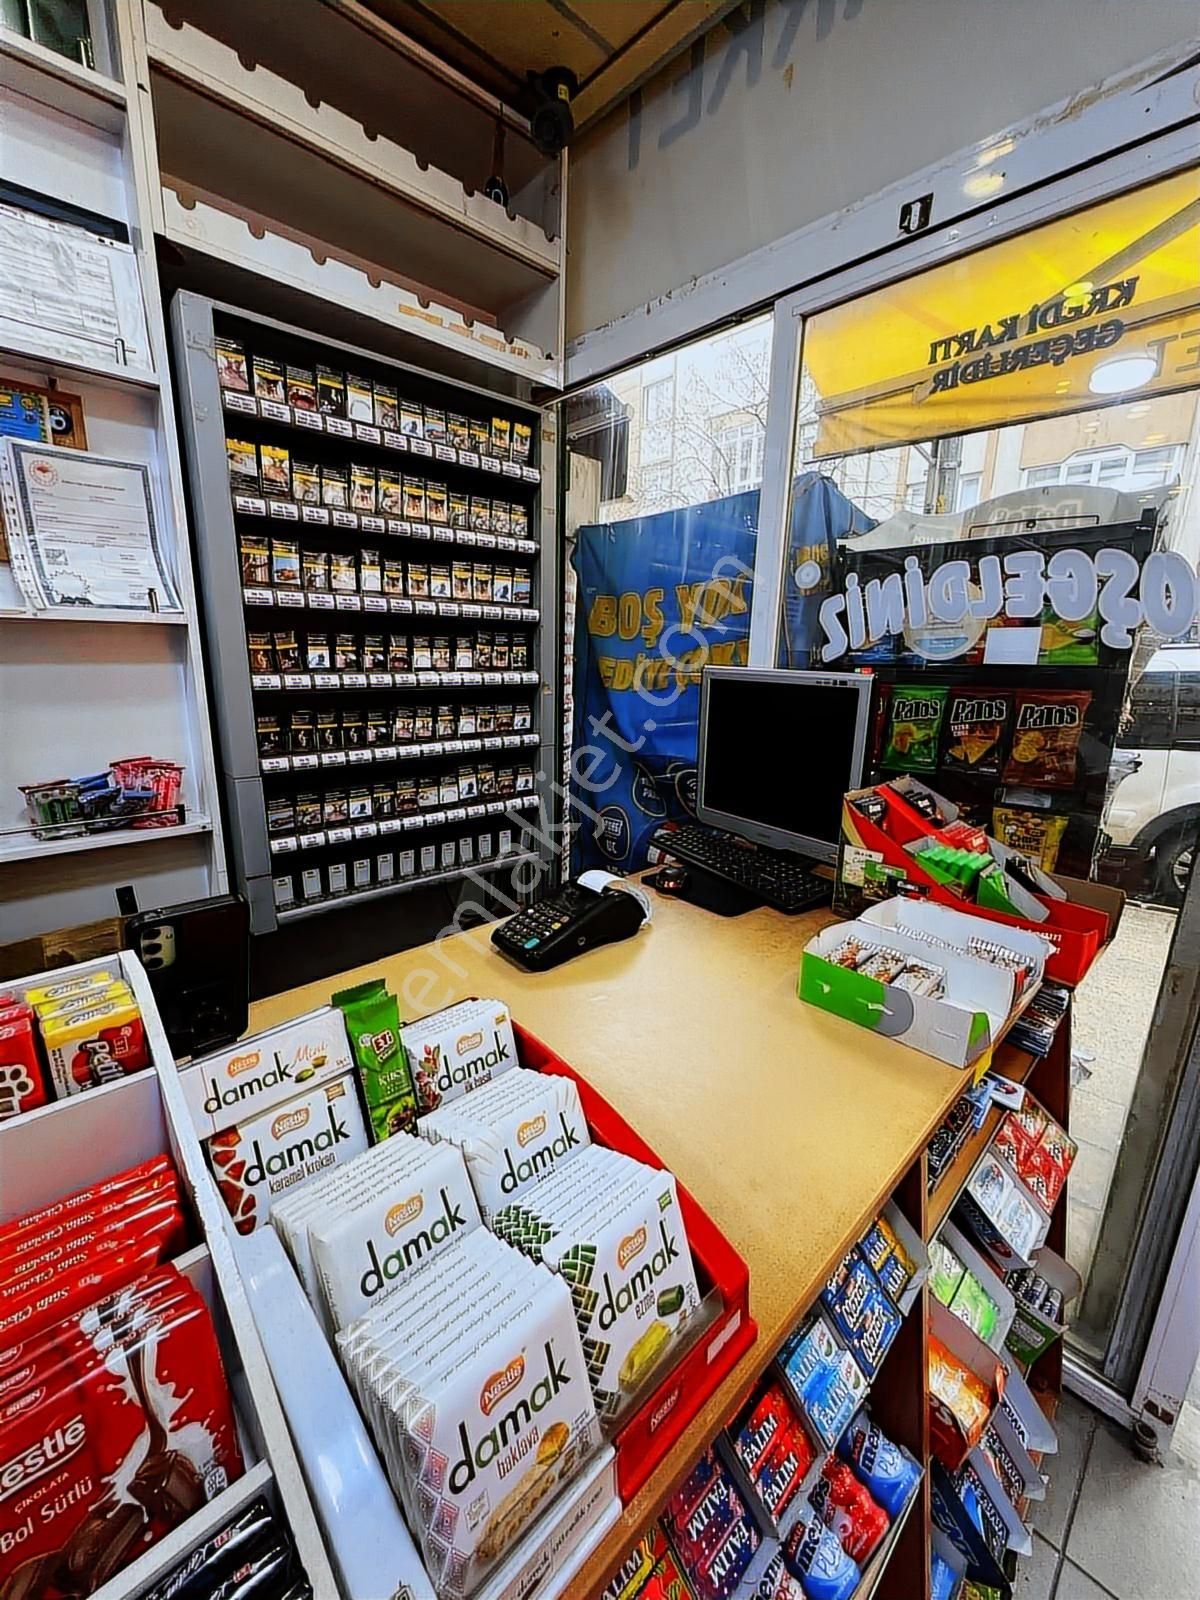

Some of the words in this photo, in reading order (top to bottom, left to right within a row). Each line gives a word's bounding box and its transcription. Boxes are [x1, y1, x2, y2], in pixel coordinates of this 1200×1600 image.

[588, 588, 664, 648] BOŞ
[599, 652, 671, 691] EDİYE
[204, 1051, 294, 1114] damak
[438, 1031, 511, 1092] damak
[244, 1104, 351, 1187] damak
[500, 1111, 580, 1194] damak
[360, 1187, 468, 1298] damak
[599, 1219, 680, 1331] damak
[448, 1340, 572, 1495] damak
[742, 1413, 779, 1466] FALIM
[0, 1415, 87, 1490] estlé
[496, 1425, 540, 1480] baklava
[762, 1452, 799, 1513] FALIM
[0, 1518, 35, 1554] Bol
[40, 1476, 94, 1525] Sütlü
[686, 1477, 729, 1543] FALIM
[602, 1550, 643, 1600] ALIM
[708, 1520, 750, 1589] FALIM
